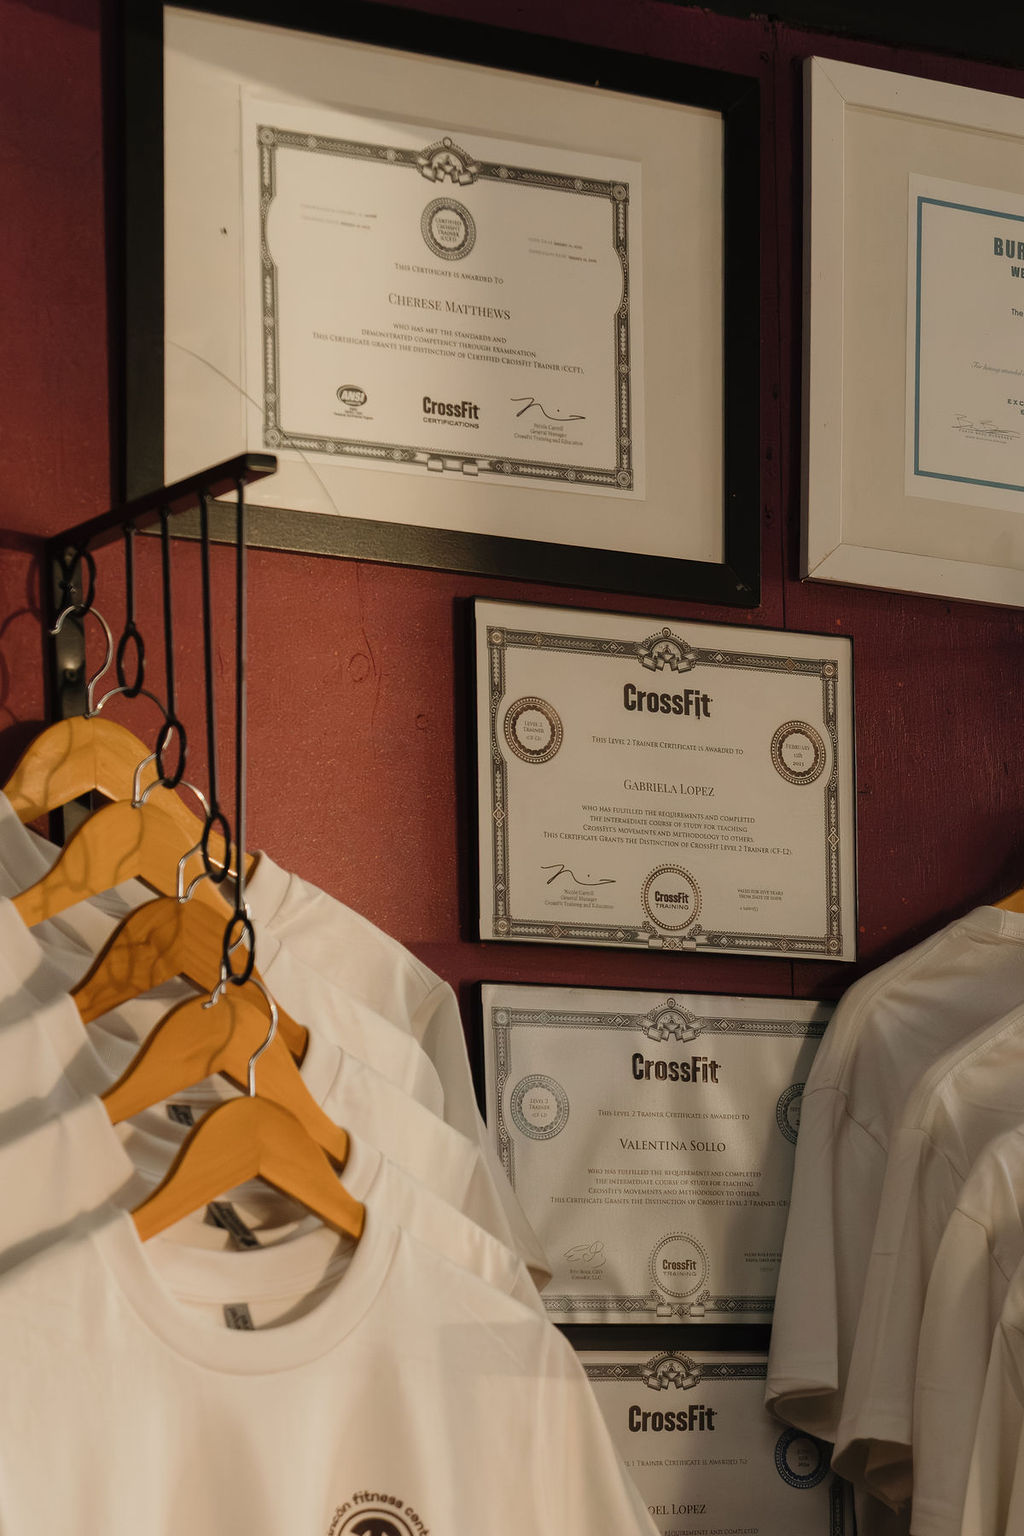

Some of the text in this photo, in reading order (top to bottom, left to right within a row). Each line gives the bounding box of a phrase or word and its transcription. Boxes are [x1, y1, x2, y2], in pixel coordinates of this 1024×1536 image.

[388, 293, 511, 320] CHERESE MATTHEWS
[1012, 308, 1023, 318] The
[423, 396, 480, 420] CrossFit
[423, 417, 480, 429] CERTIFICATIONS
[624, 683, 711, 717] CrossFit
[624, 779, 714, 797] GABRIELA LOPEZ
[655, 891, 688, 904] CrossFit
[632, 1053, 719, 1083] CrossFit
[619, 1138, 726, 1152] VALENTINA SOLLO
[662, 1259, 696, 1270] CrossFit
[628, 1405, 715, 1432] CrossFit
[352, 1490, 404, 1509] fitness
[672, 1504, 706, 1514] LOPEZ
